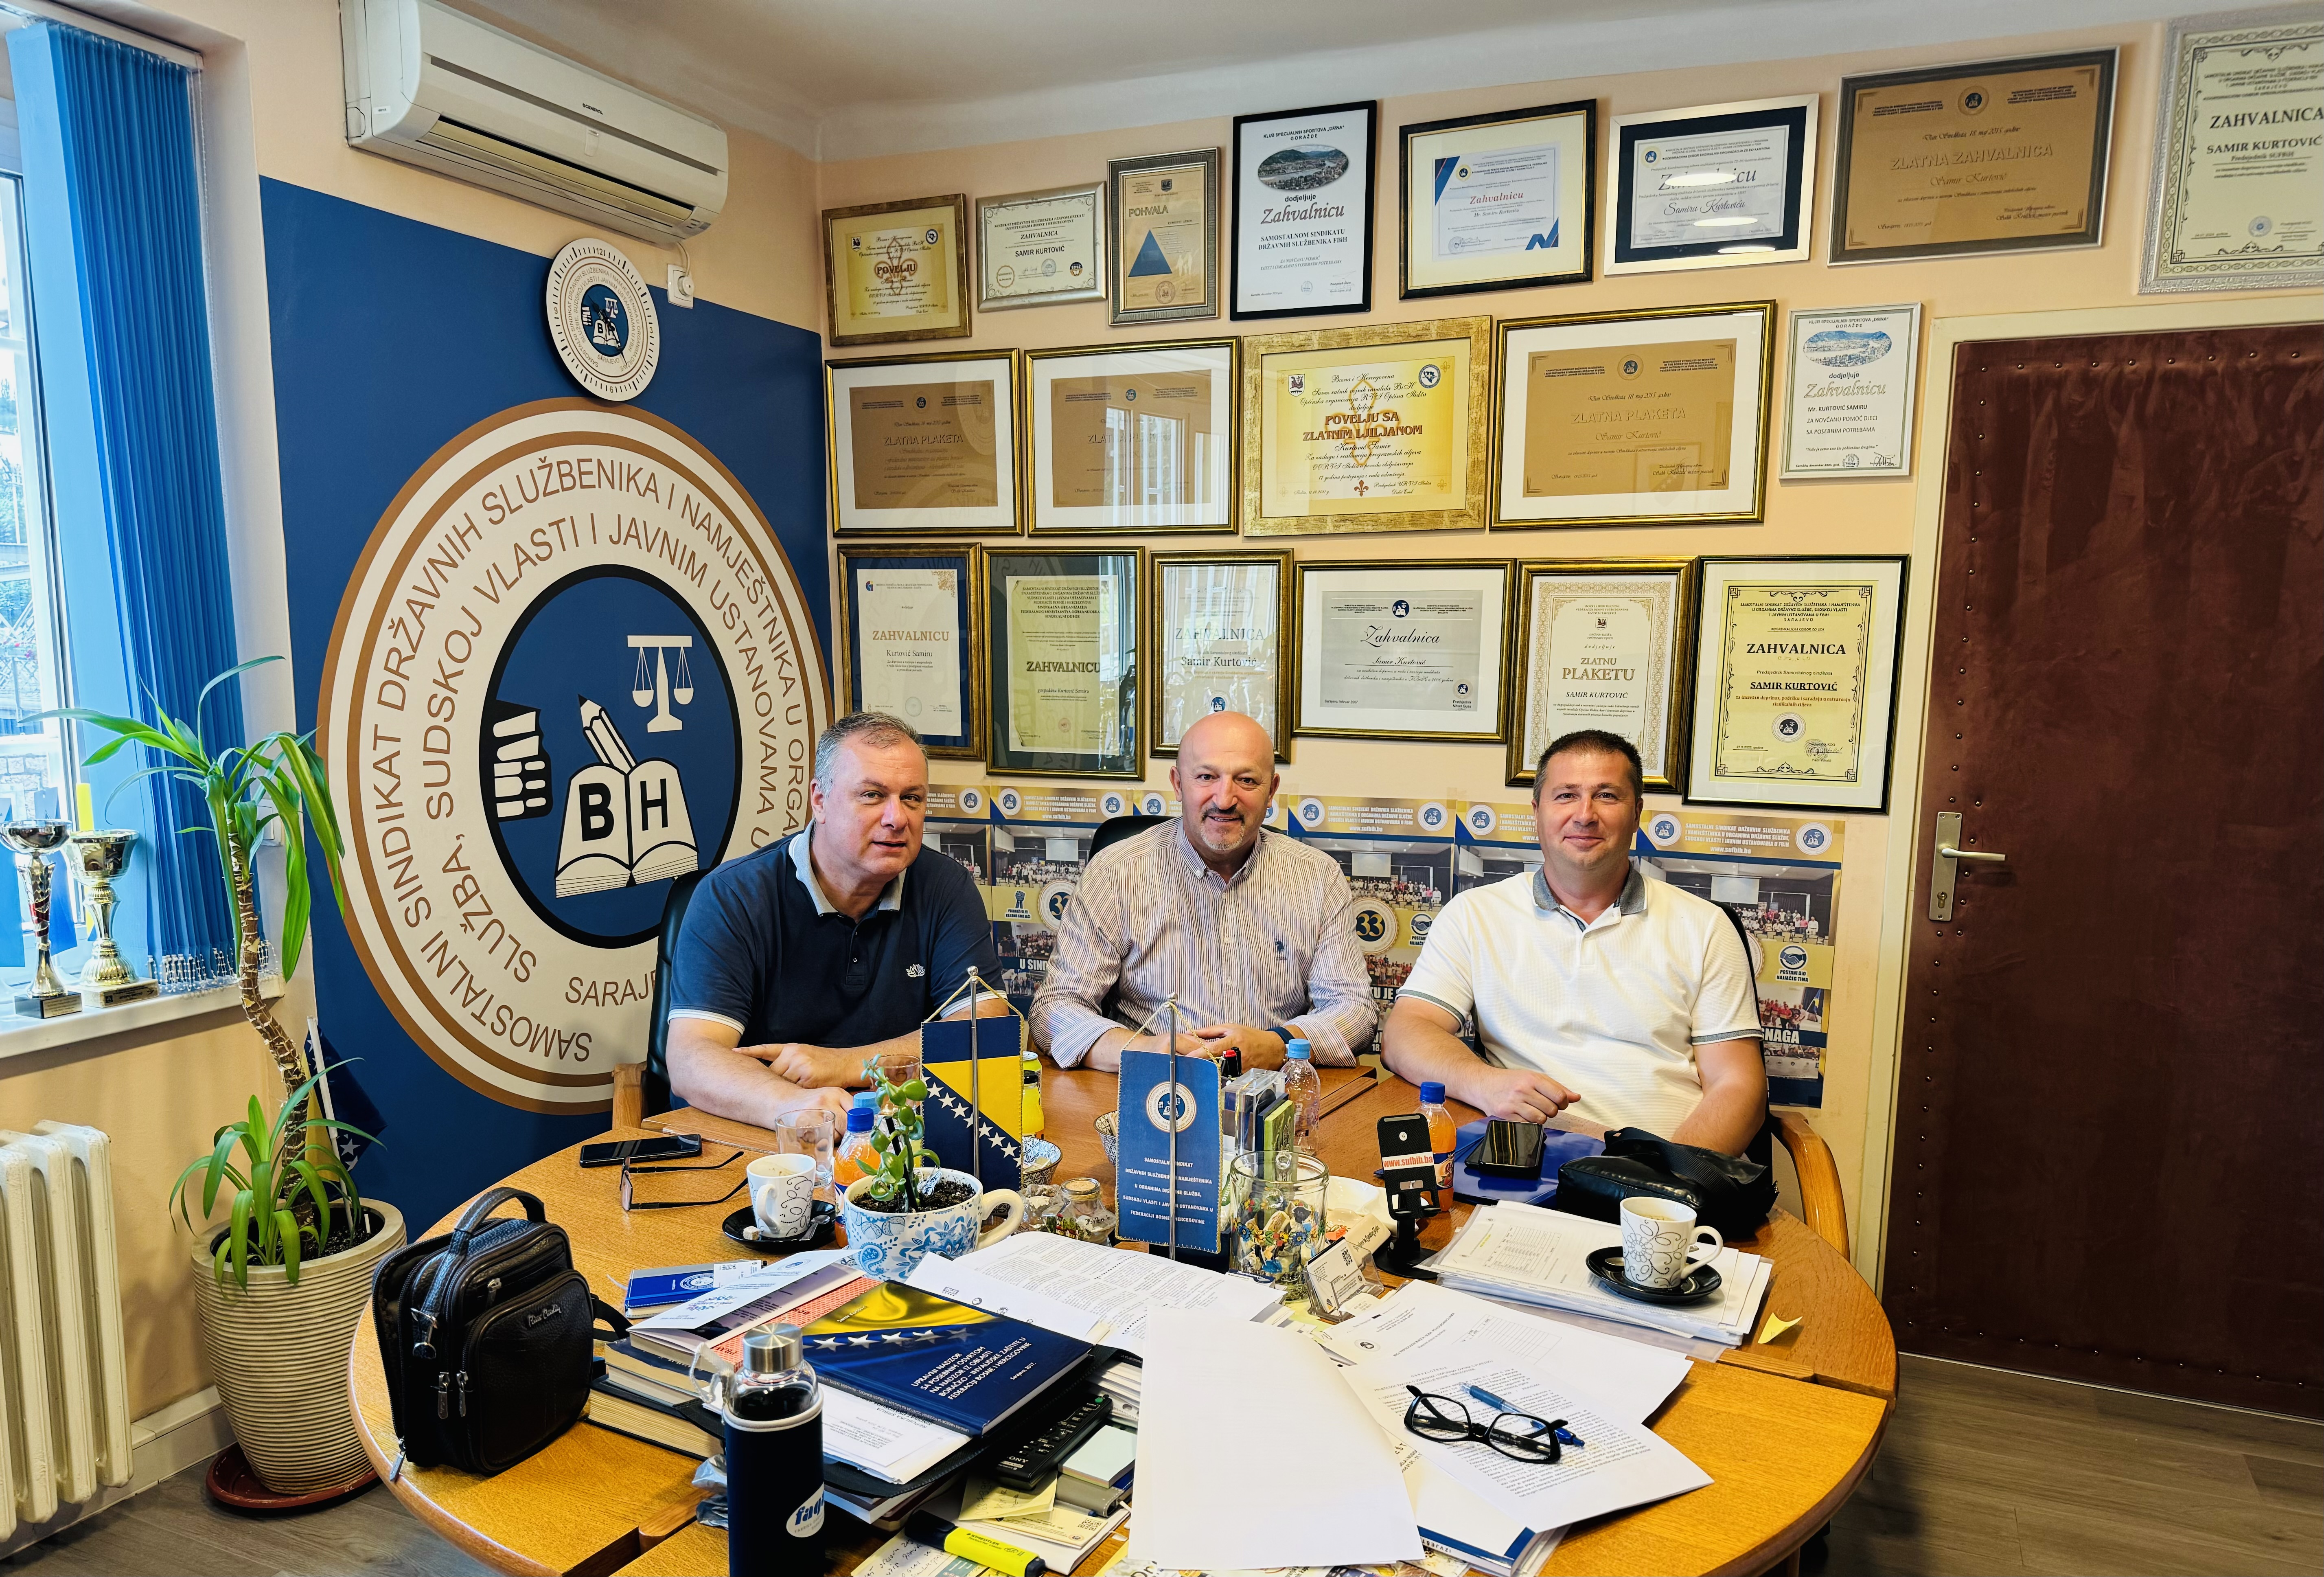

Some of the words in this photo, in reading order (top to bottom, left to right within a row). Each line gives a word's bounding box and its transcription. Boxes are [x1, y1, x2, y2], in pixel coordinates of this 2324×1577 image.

[2210, 107, 2324, 129] ZAHVALNICA
[2207, 142, 2248, 154] SAMIR
[2252, 134, 2323, 150] KURTOVIĆ
[1890, 153, 1949, 171] ZLATNA
[1952, 143, 2053, 164] ZAHVALNICA
[1285, 193, 1316, 202] dodjeljuje
[1470, 191, 1524, 204] Zahvalnicu
[1664, 202, 1698, 215] Samiru
[1700, 197, 1746, 213] Kurtoviću
[1129, 205, 1168, 217] POHVALA
[1260, 202, 1344, 225] Zahvalnicu
[1021, 230, 1058, 239] ZAHVALNICA
[1259, 241, 1290, 250] DRŽAVNIH
[1292, 238, 1332, 248] SLUŽBENIKA
[1261, 232, 1309, 241] SAMOSTALNOM
[1310, 229, 1345, 238] SINDIKATU
[1036, 245, 1065, 254] KURTOVIĆ
[877, 264, 915, 274] POVELJU
[1804, 380, 1886, 398] Zahvalnicu
[1325, 413, 1379, 425] POVELJU
[1382, 412, 1399, 421] SA
[1571, 409, 1621, 424] ZLATNA
[1625, 408, 1686, 421] PLAKETA
[883, 435, 919, 446] ZLATNA
[922, 434, 963, 445] PLAKETA
[1303, 429, 1352, 441] ZLATNIM
[1356, 425, 1423, 438] LJILJANOM
[1626, 430, 1662, 441] Kurtović
[482, 456, 660, 525] SLUŽBENIKA
[668, 483, 676, 510] I
[590, 512, 598, 544] I
[473, 515, 580, 605] VLASTI
[609, 513, 710, 589] JAVNIM
[681, 493, 797, 698] NAMJEŠTNIKA
[377, 512, 483, 712] DRŽAVNIH
[872, 630, 949, 641] ZAHVALNICU
[1360, 625, 1441, 647] Zahvalnica
[1746, 643, 1846, 655] ZAHVALNICA
[1026, 661, 1100, 673] ZAHVALNICU
[1181, 656, 1210, 666] Samir
[1213, 657, 1257, 667] Kurtović
[1372, 656, 1393, 665] Samir
[1395, 657, 1426, 665] Kurtović
[1562, 668, 1636, 681] PLAKETU
[710, 579, 778, 814] USTANOVAMA
[1785, 682, 1838, 691] KURTOVIĆ
[423, 605, 483, 820] SUDSKOJ
[785, 703, 803, 726] U
[782, 738, 804, 836] ORGA
[579, 782, 615, 842] B
[640, 778, 669, 832] H
[372, 723, 432, 928] SINDIKAT
[751, 827, 769, 849] U
[442, 833, 537, 983] SLUŽBA,
[1356, 913, 1383, 937] 33
[421, 930, 592, 1062] SAMOSTALNI
[1383, 988, 1393, 999] JE
[1144, 1157, 1170, 1165] SAMOSTALN
[1383, 1154, 1433, 1169] www.sufbih.ba
[1178, 1176, 1212, 1184] NAMJEŠTENIKA
[1180, 1204, 1209, 1212] USTANOVAMA
[911, 1368, 939, 1387] UPRAVNI
[936, 1353, 963, 1370] NADZOR
[930, 1363, 959, 1385] POSEBNIM
[957, 1346, 986, 1366] OSVRTOM
[938, 1376, 968, 1397] BORAČKO
[999, 1340, 1022, 1355] ZAŠTITE
[939, 1369, 964, 1387] NADZOR
[969, 1350, 993, 1367] OBLASTI
[948, 1380, 977, 1400] FEDERACIJI
[978, 1367, 995, 1381] BOSNE
[996, 1342, 1032, 1367] HERCEGOVINE
